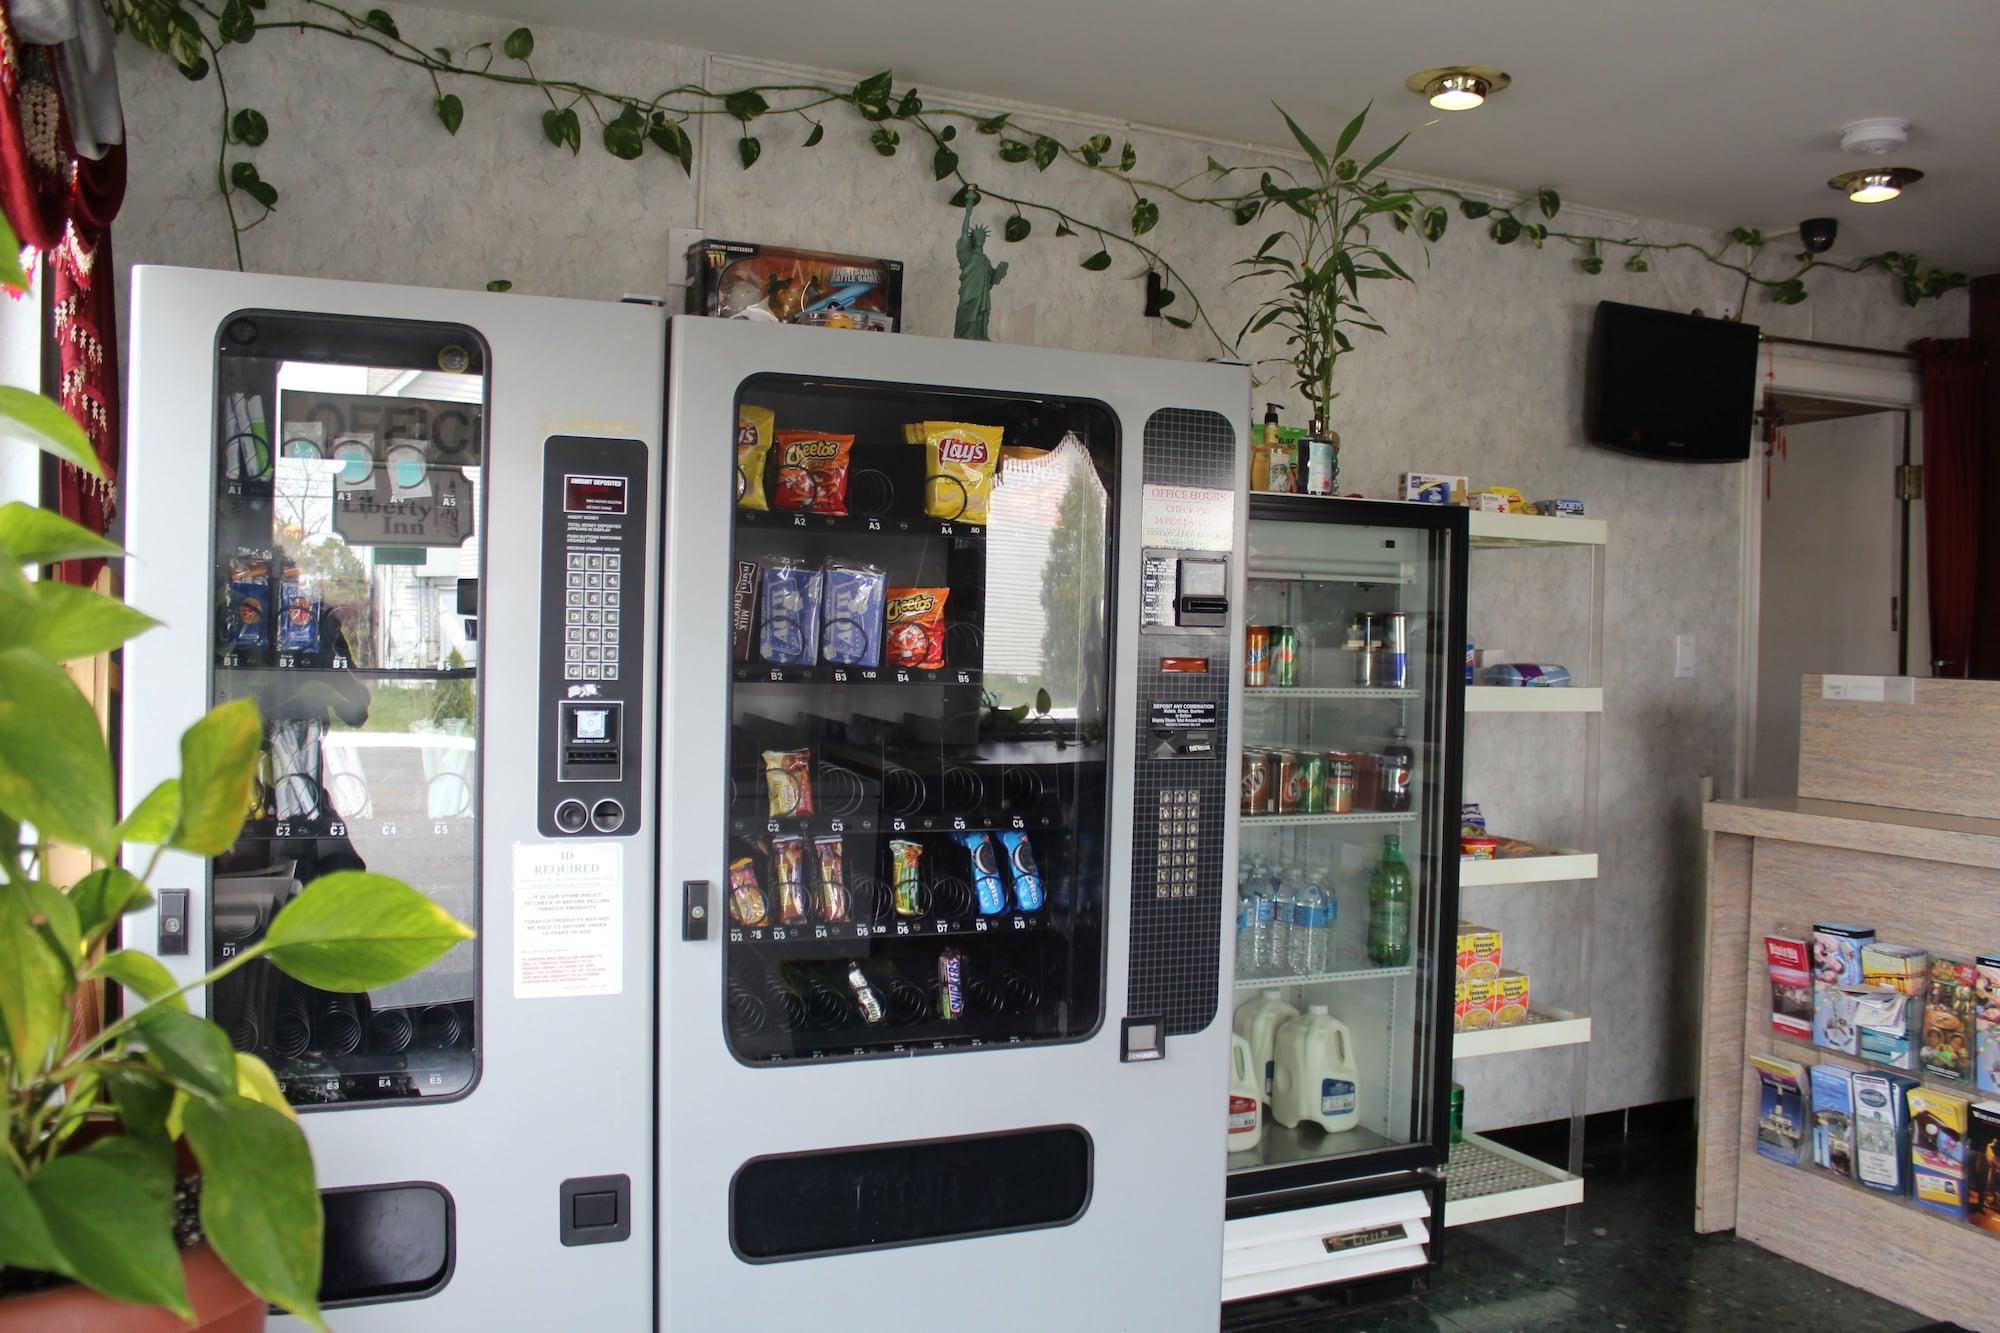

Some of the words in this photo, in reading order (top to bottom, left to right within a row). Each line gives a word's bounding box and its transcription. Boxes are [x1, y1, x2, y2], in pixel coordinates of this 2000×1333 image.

[784, 440, 838, 465] Cheetos
[228, 486, 242, 495] A1
[1152, 489, 1188, 499] OFFICE
[337, 492, 352, 501] A3
[342, 497, 432, 517] Liberty
[443, 498, 456, 507] A5
[384, 516, 424, 535] Inn
[794, 517, 806, 526] A2
[868, 522, 880, 531] A3
[942, 526, 953, 535] A4
[887, 594, 935, 622] Cheetos
[224, 657, 239, 667] B1
[280, 658, 294, 668] B2
[333, 659, 348, 669] B3
[437, 661, 451, 671] B5
[771, 671, 783, 681] B2
[835, 672, 847, 682] B3
[862, 671, 876, 679] 1.00
[897, 673, 909, 683] B4
[958, 674, 970, 683] B5
[434, 824, 448, 834] C5
[767, 823, 780, 832] C2
[831, 823, 843, 832] C3
[894, 822, 905, 831] C4
[954, 821, 966, 829] C5
[1013, 820, 1024, 828] C6
[276, 826, 291, 836] C2
[330, 826, 345, 836] C3
[383, 826, 397, 836] C4
[560, 851, 574, 861] ID
[534, 863, 600, 875] REQUIRED
[986, 877, 999, 906] OREO
[1024, 875, 1038, 904] OREO
[937, 924, 948, 933] D7
[976, 922, 987, 931] D8
[1015, 920, 1025, 929] D9
[750, 931, 762, 939] .75
[816, 929, 827, 938] D4
[857, 928, 869, 937] D5
[872, 926, 886, 934] 1.00
[897, 926, 909, 934] D6
[731, 933, 743, 942] D2
[774, 931, 785, 940] D3
[223, 946, 236, 957] D1
[327, 1080, 339, 1090] E3
[379, 1078, 391, 1088] E4
[430, 1076, 442, 1086] E5
[1353, 1230, 1389, 1247] true
